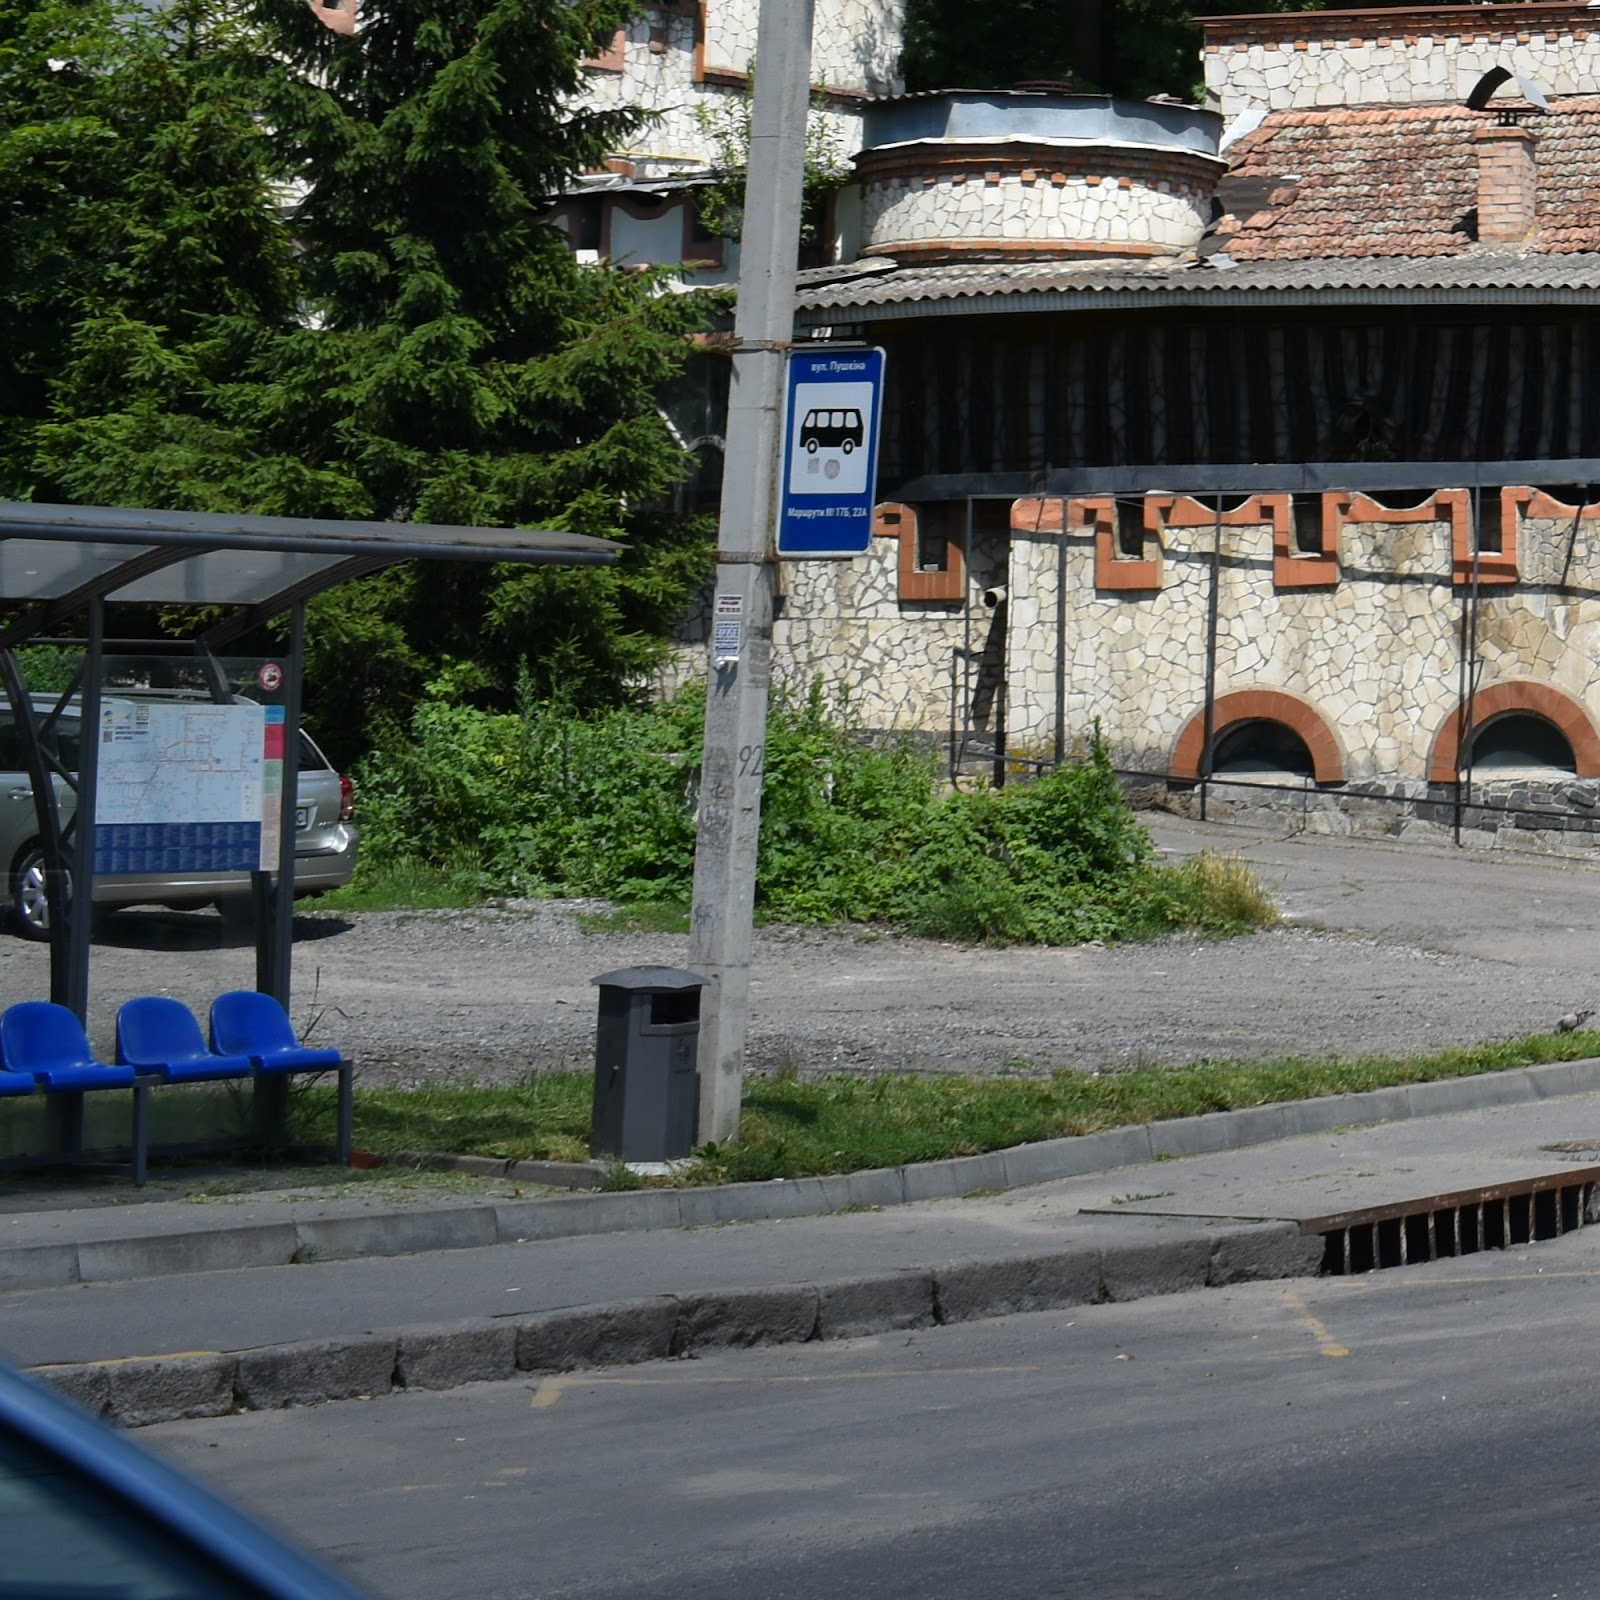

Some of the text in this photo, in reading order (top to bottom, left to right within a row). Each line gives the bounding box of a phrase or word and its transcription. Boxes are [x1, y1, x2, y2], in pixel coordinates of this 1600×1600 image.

[811, 360, 866, 373] вул. Пушкіна
[788, 507, 824, 519] Маршрути
[737, 745, 763, 777] 92
